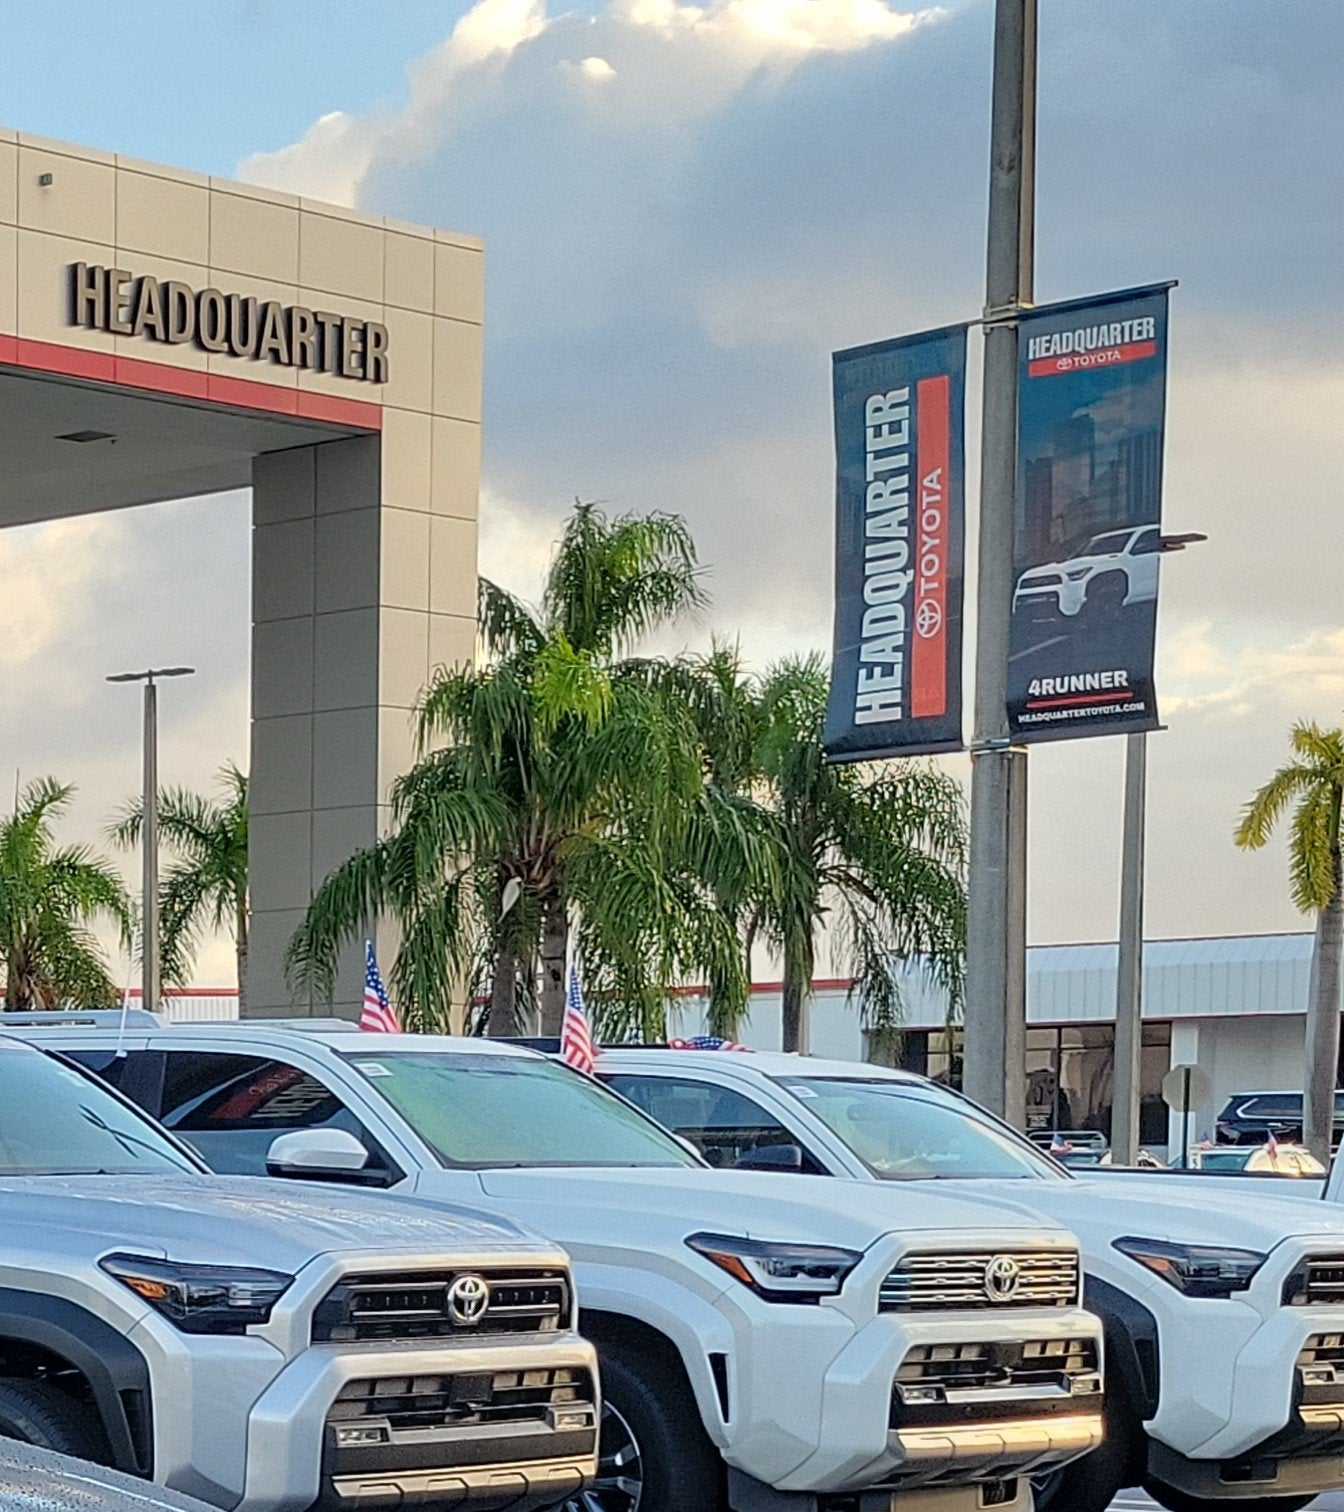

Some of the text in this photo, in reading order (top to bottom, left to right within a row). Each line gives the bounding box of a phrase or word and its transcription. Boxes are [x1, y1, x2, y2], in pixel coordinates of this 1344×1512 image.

[67, 261, 390, 384] HEADQUARTER
[1027, 316, 1156, 360] HEADQUARTER
[1072, 349, 1122, 369] TOYOTA
[918, 467, 943, 597] TOYOTA
[855, 386, 913, 725] HEADQUARTER
[1028, 670, 1129, 698] 4RUNNER
[1018, 701, 1145, 724] HEADQUARTERTOYOTA.COM
